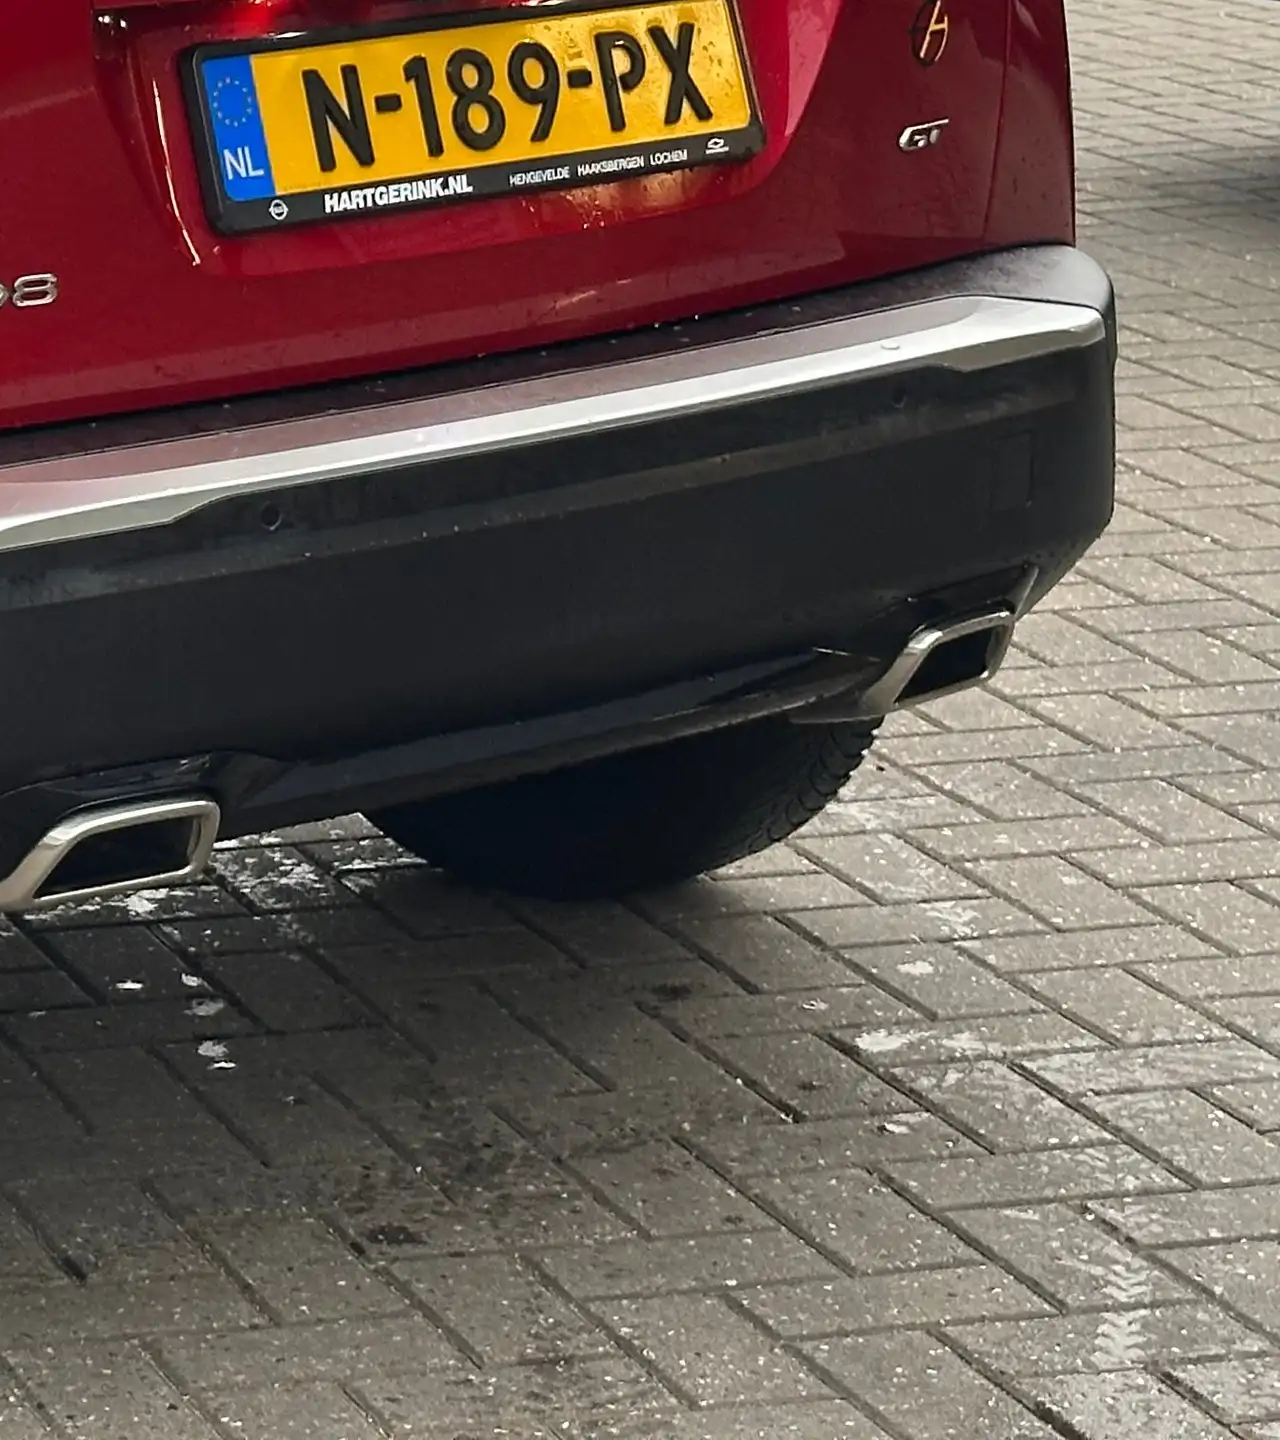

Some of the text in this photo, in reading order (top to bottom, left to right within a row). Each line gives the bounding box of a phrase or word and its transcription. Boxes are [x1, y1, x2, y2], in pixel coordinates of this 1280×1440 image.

[301, 21, 713, 172] N-189-PX
[898, 118, 949, 151] GT
[222, 146, 265, 182] NL
[509, 148, 688, 188] HENGEVELDE HAAKSBERGEN LOCHEM
[323, 173, 474, 215] HARTGERINK.NL
